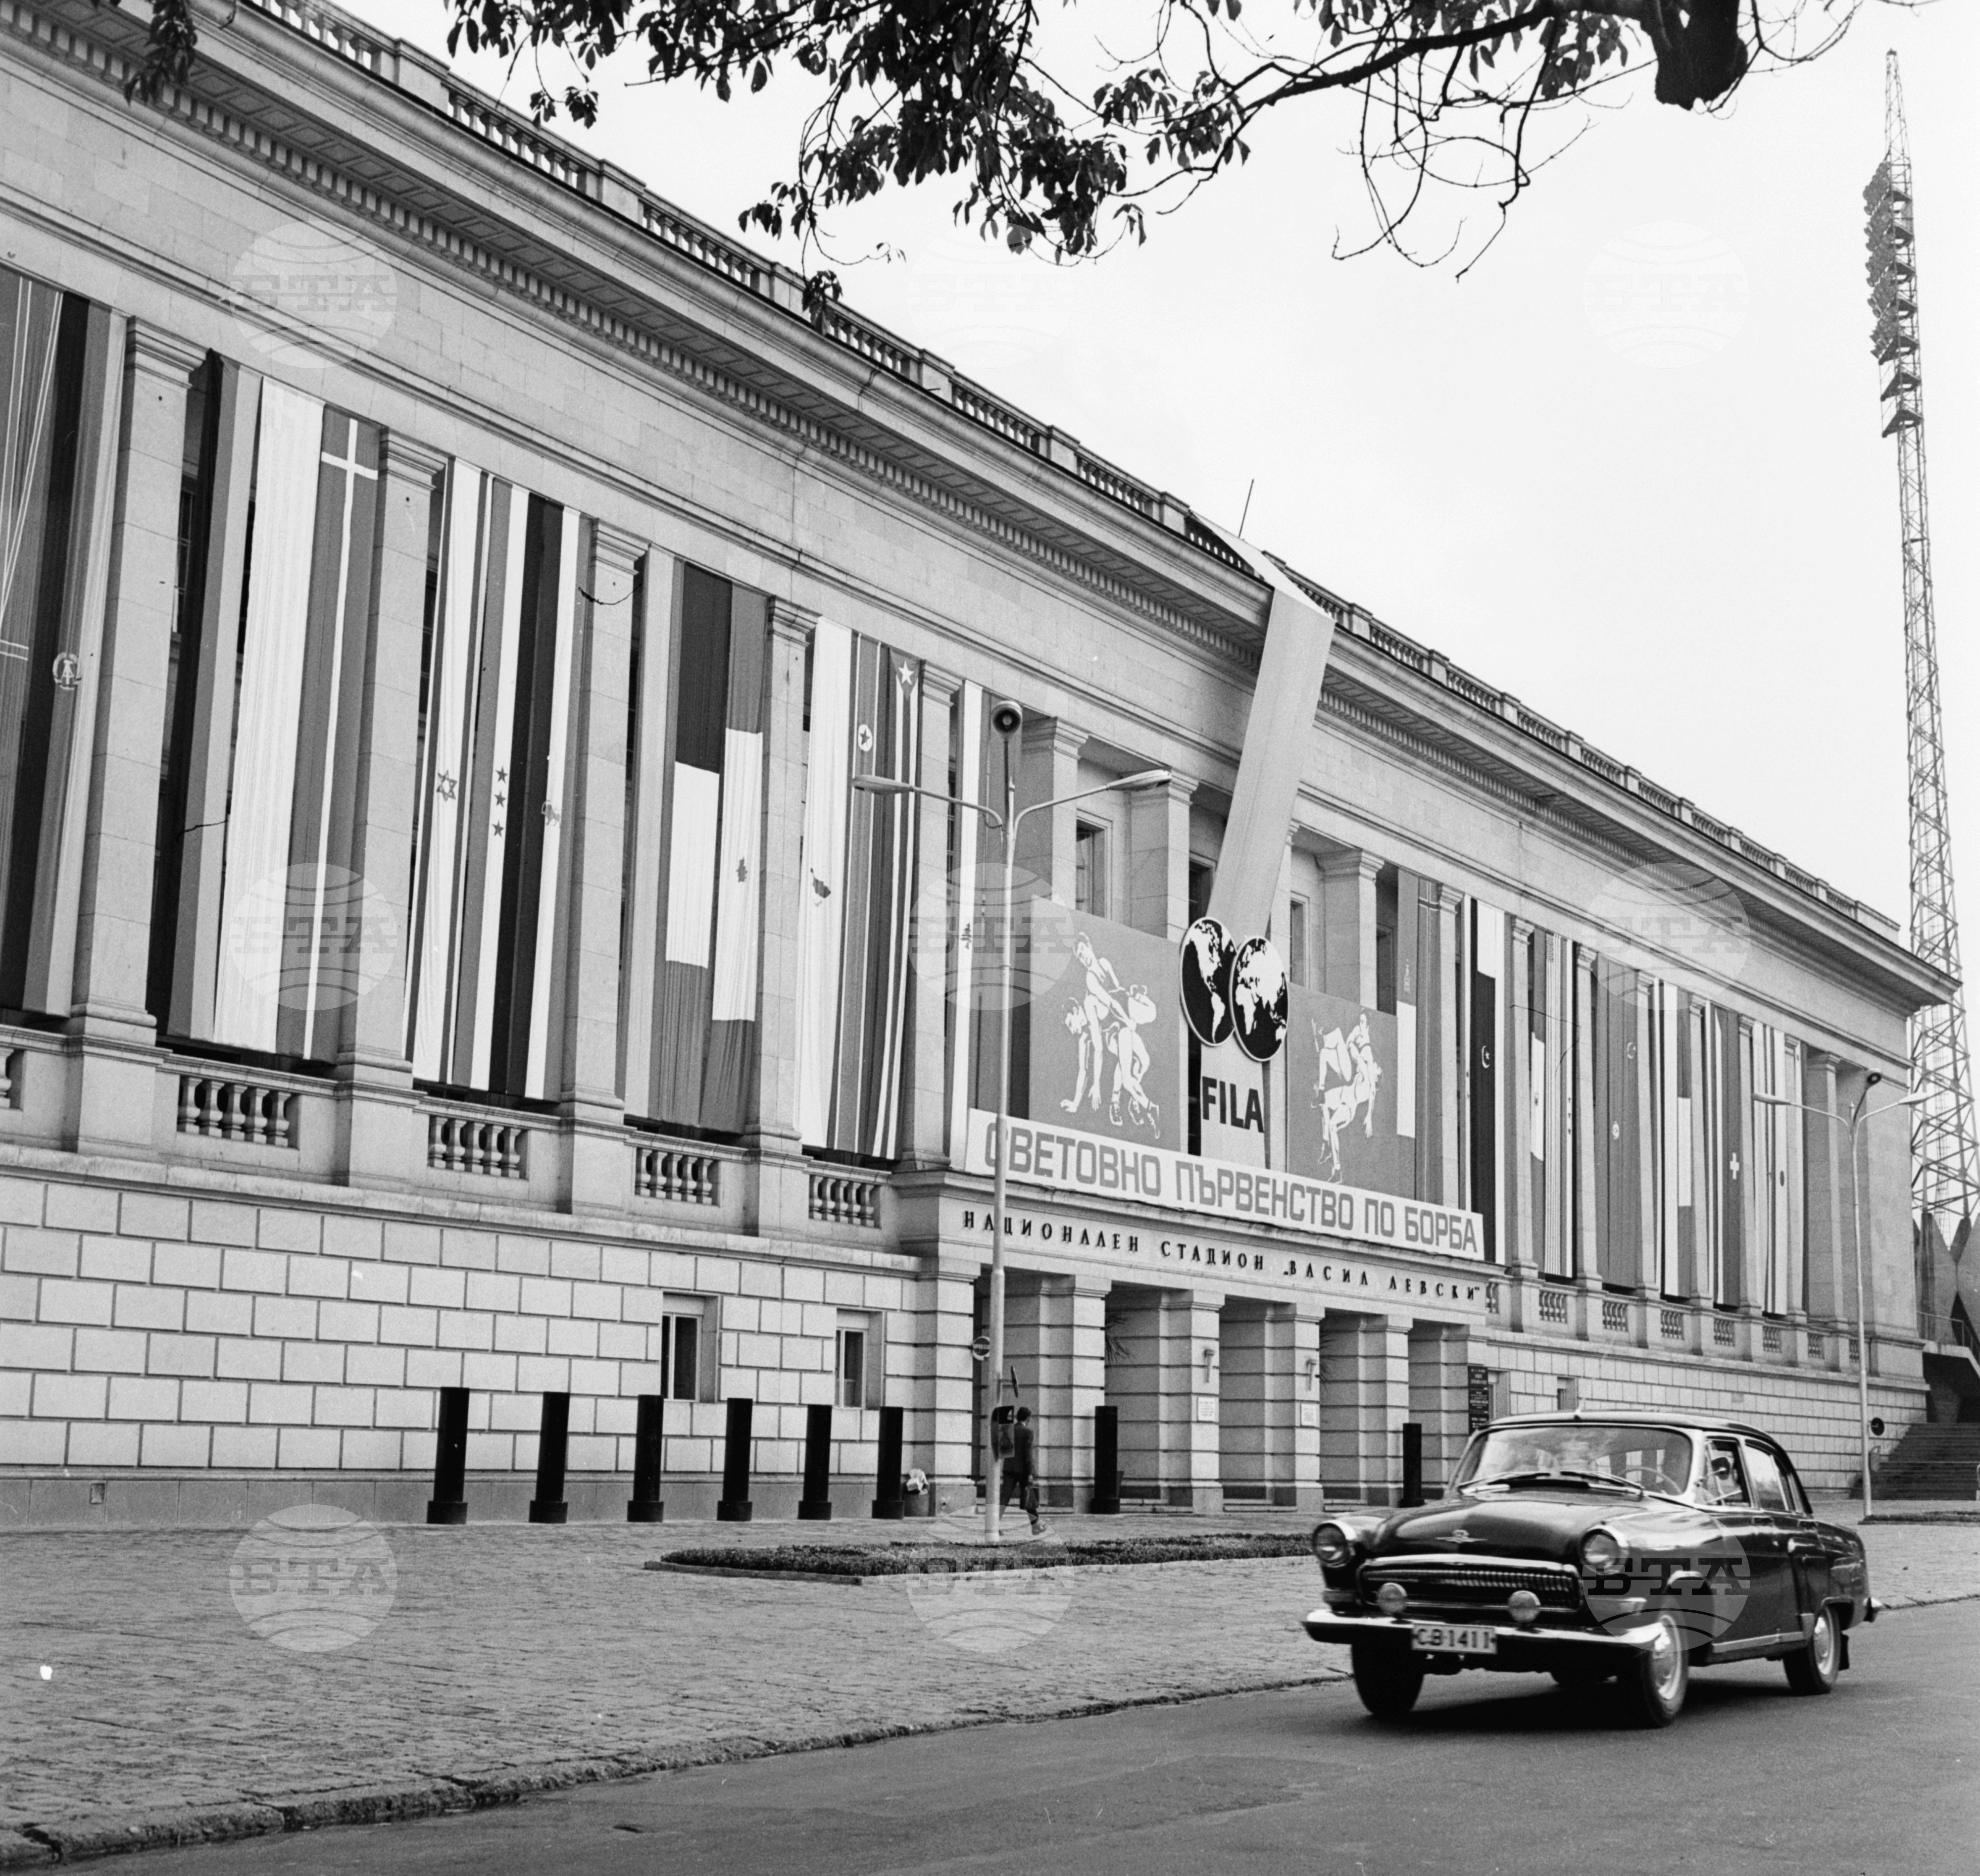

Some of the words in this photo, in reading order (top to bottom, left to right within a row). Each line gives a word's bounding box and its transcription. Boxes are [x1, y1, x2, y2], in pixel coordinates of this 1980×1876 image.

[1202, 1076, 1264, 1133] FILA
[985, 1122, 1161, 1197] СВЕТОВНО
[1176, 1160, 1353, 1231] ПЪРВЕНСТВО
[1365, 1198, 1394, 1237] ПО
[1404, 1206, 1478, 1253] БОРБА
[964, 1211, 1138, 1252] НАЦИОНАЛЕН
[1161, 1241, 1263, 1271] СТАДИОН
